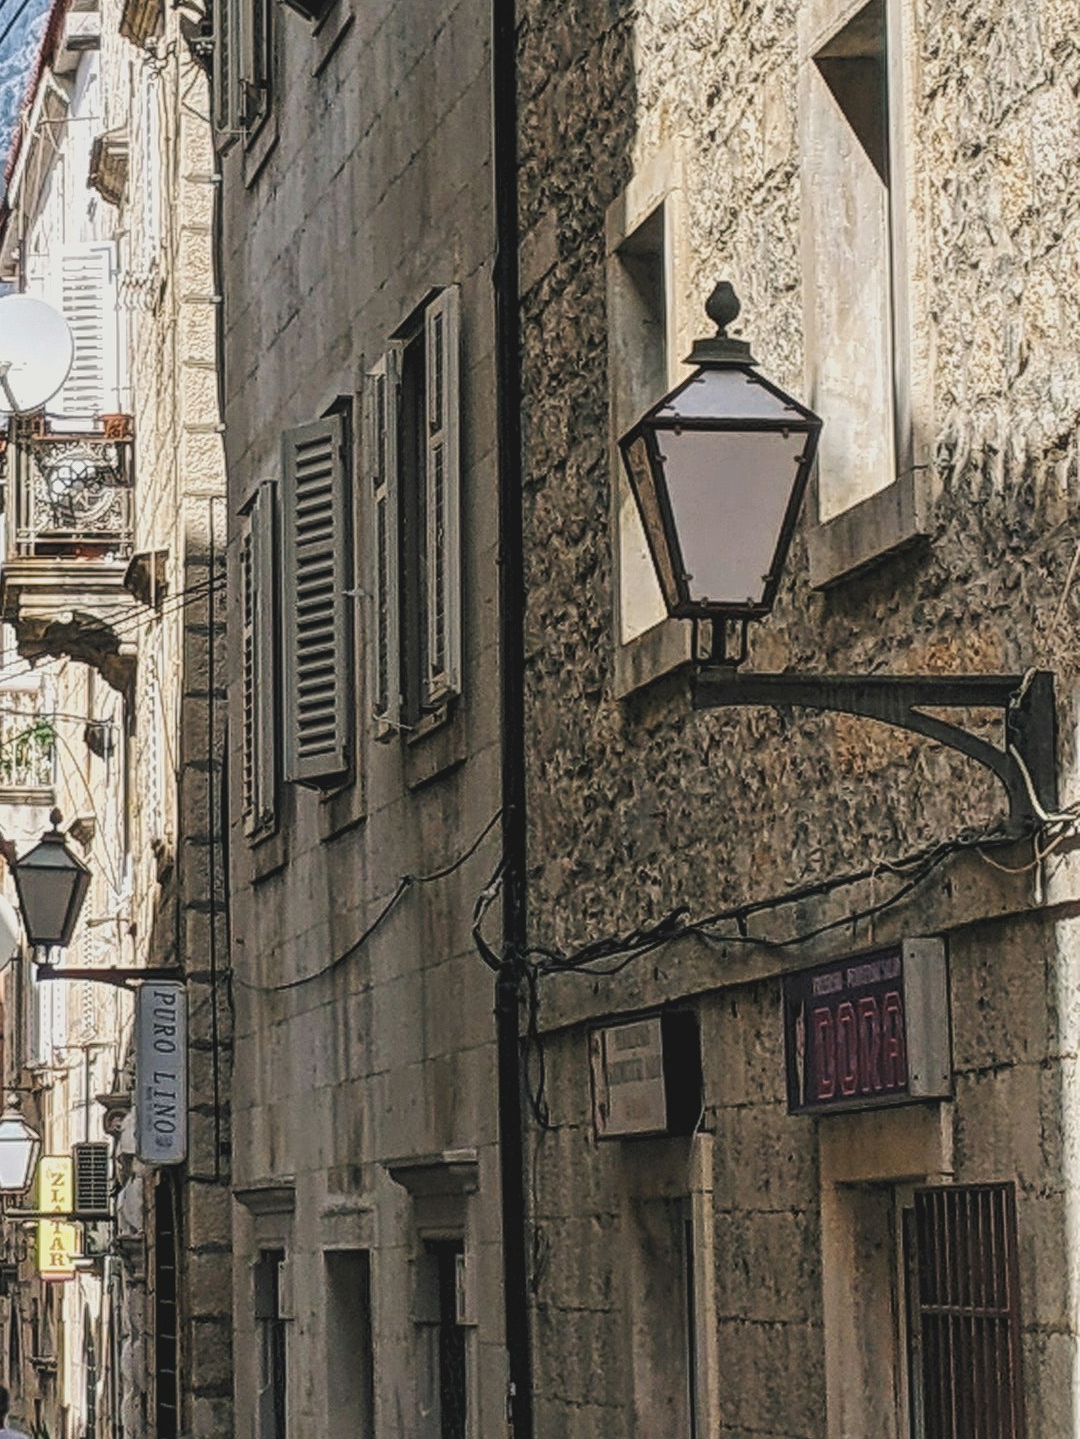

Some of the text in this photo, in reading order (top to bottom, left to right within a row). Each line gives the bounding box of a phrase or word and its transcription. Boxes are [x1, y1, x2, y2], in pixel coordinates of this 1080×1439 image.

[153, 991, 176, 1054] PURO
[813, 991, 906, 1100] DORA
[153, 1072, 176, 1134] LINO
